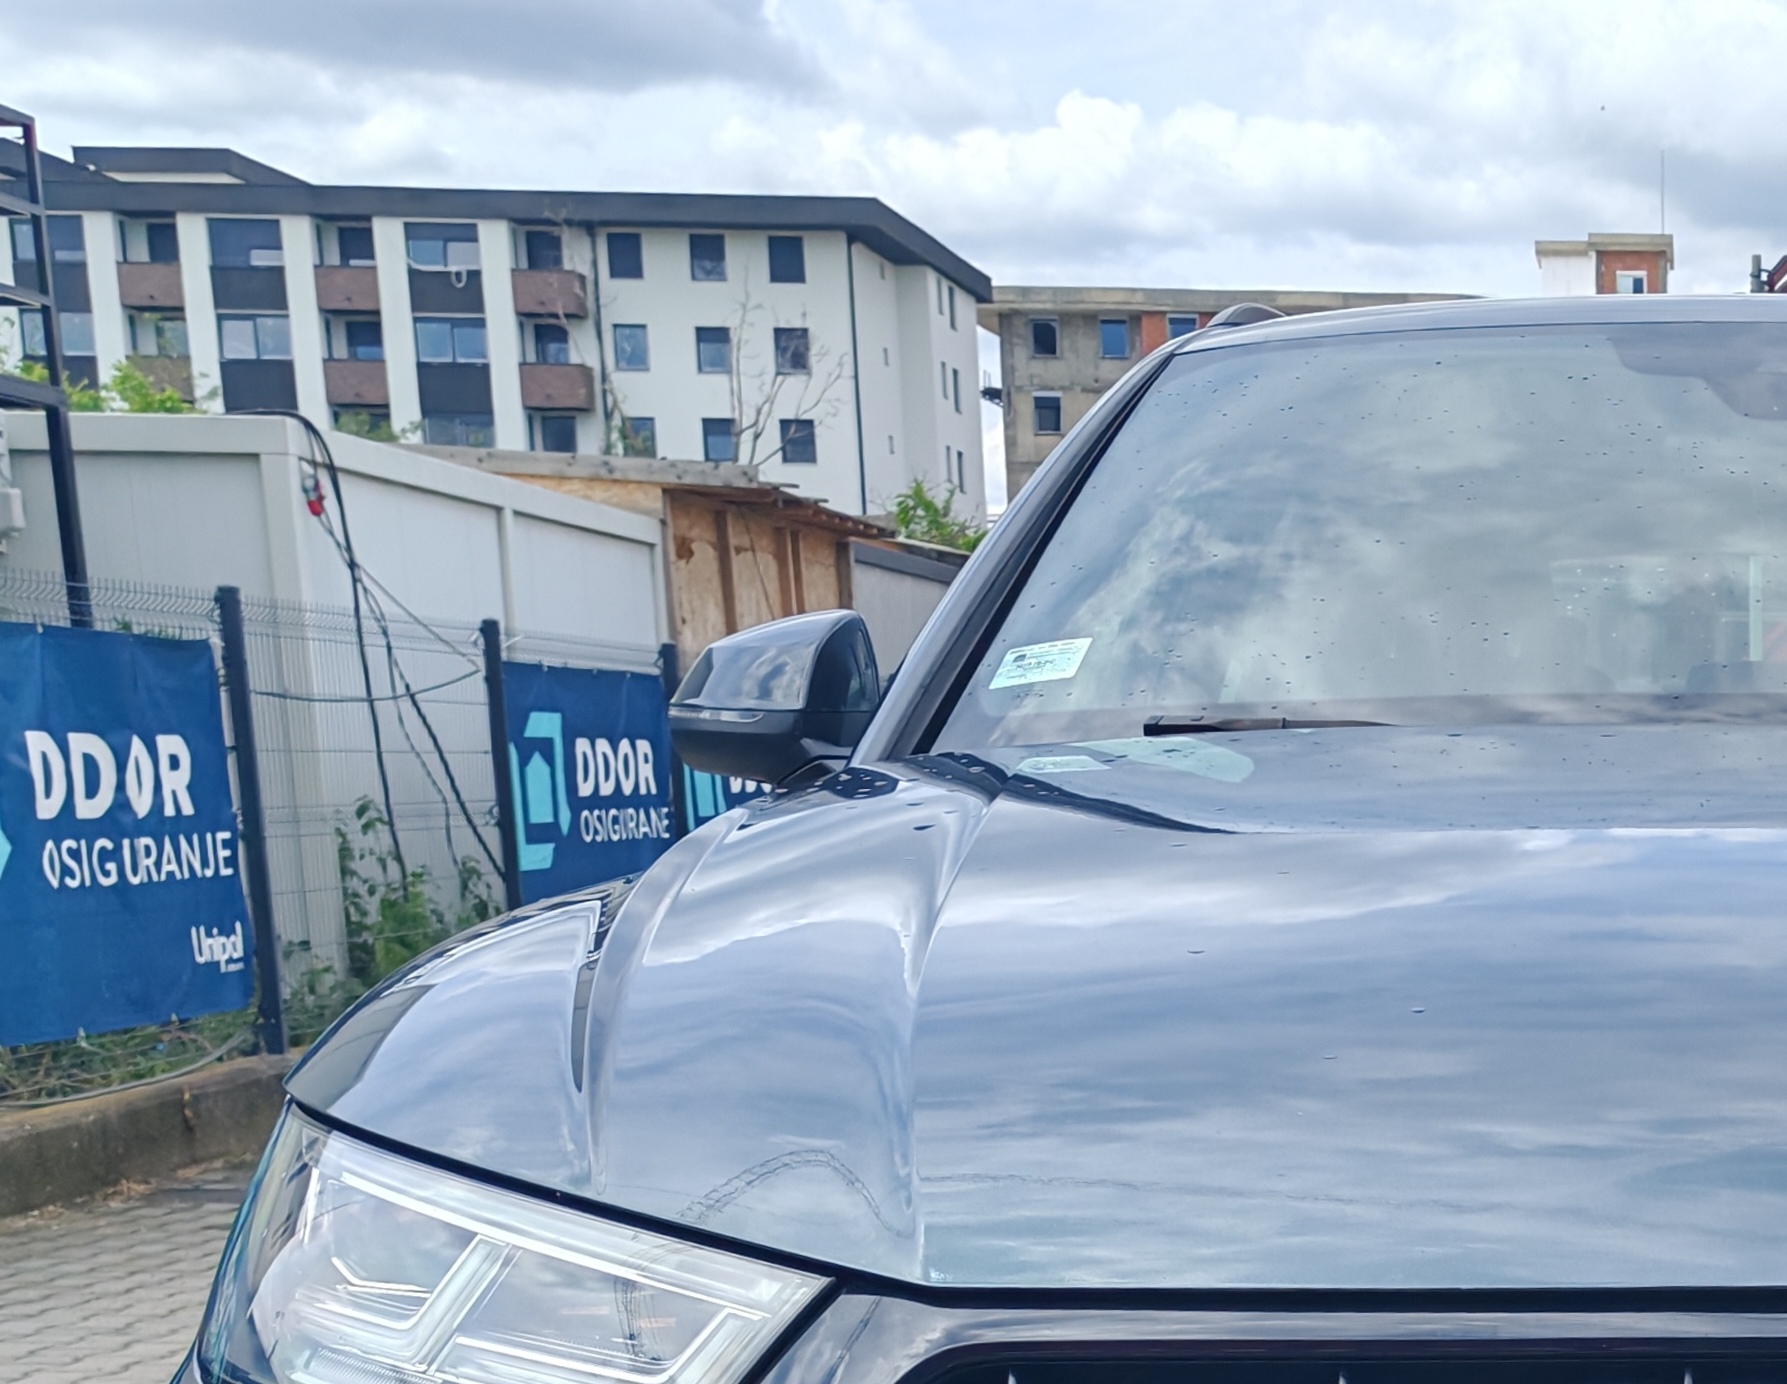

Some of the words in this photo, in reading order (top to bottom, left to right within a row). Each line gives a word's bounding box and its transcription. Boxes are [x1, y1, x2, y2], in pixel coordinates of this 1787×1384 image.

[25, 730, 195, 820] DDOR
[574, 737, 657, 797] DDOR
[42, 831, 235, 889] OSIGURANJE
